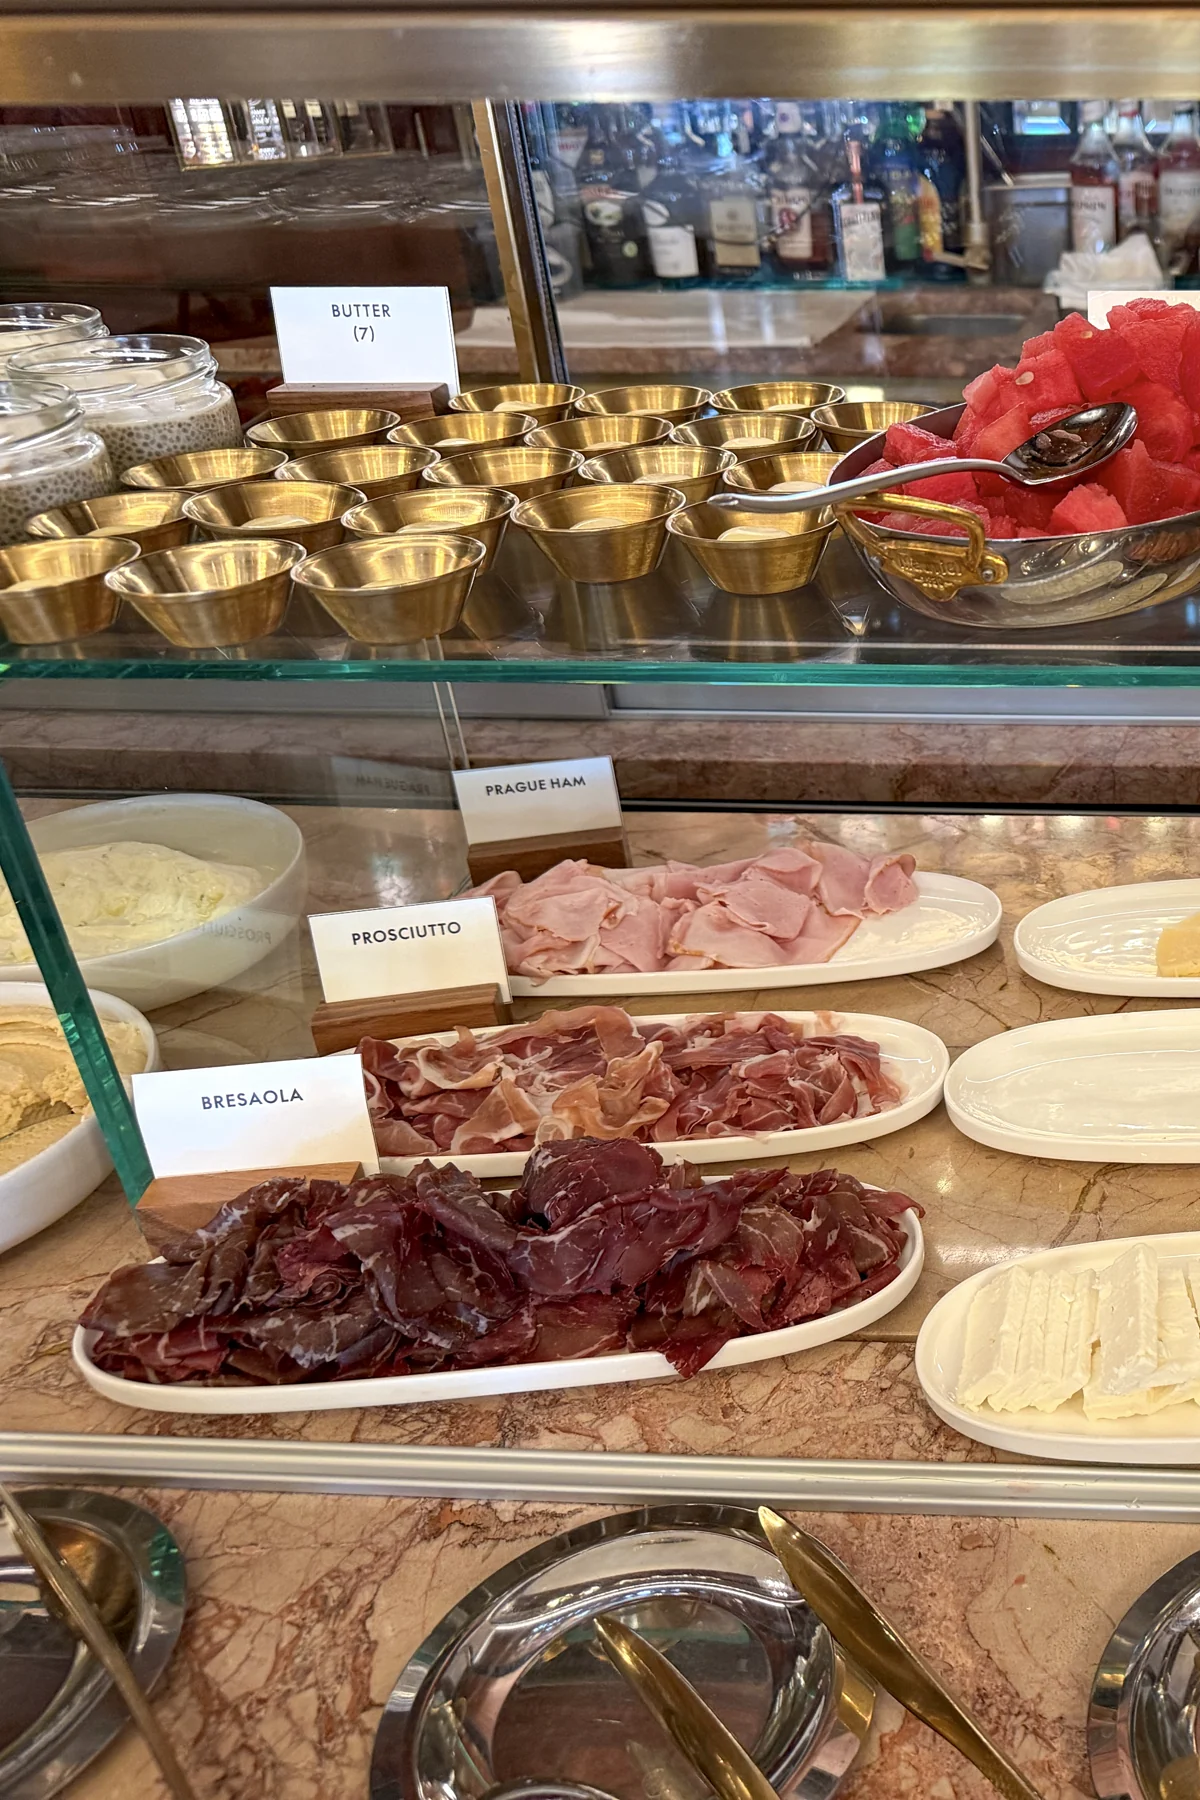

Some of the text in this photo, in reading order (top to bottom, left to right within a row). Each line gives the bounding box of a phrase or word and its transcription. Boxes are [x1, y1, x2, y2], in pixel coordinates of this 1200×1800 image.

[331, 303, 392, 318] BUTTER
[353, 325, 375, 343] (7)
[485, 775, 587, 797] PRAGUE HAM
[351, 921, 462, 946] PROSCIUTTO
[201, 1087, 304, 1110] BRESAOLA
